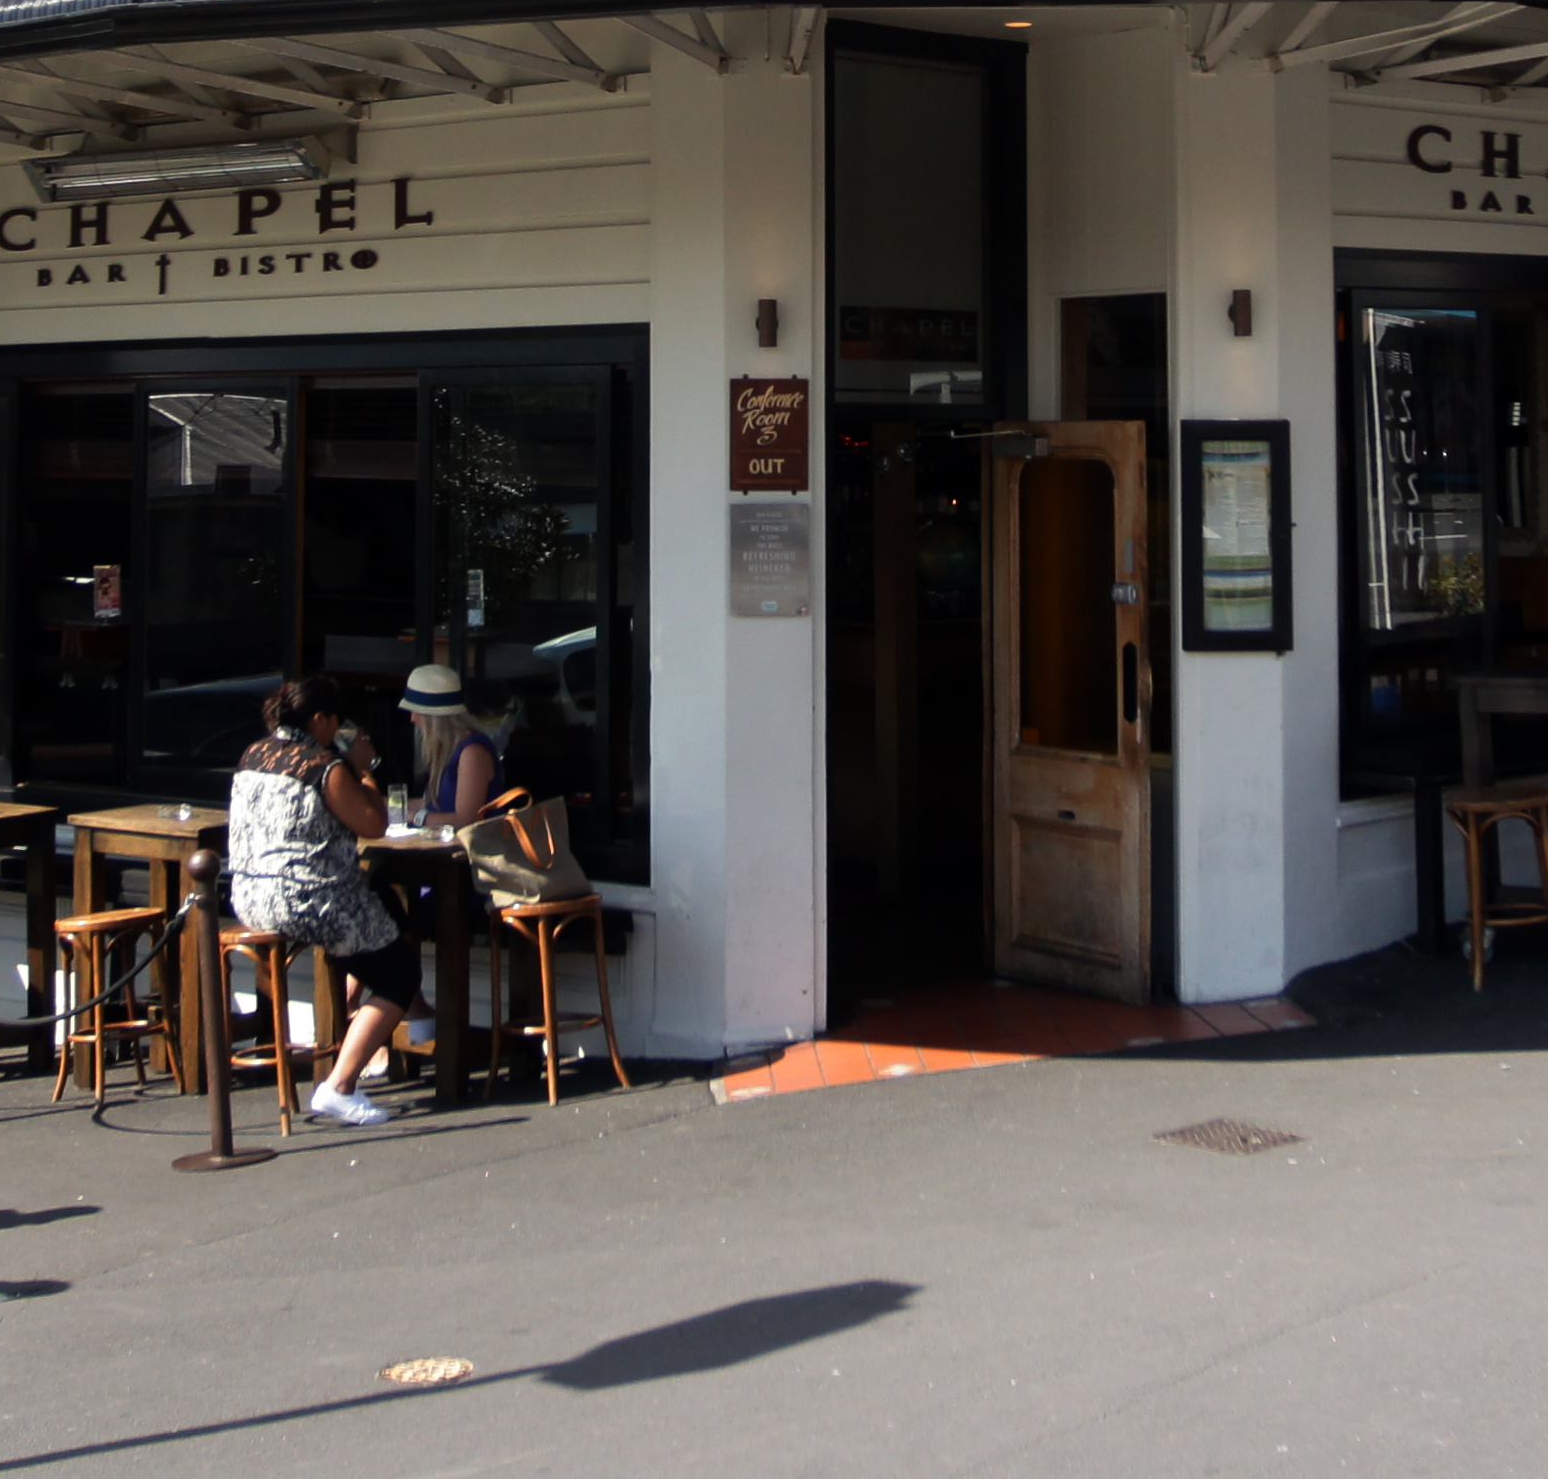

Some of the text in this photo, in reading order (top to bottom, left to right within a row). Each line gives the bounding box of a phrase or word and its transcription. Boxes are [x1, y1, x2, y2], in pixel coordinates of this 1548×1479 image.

[1450, 189, 1536, 216] BAR
[36, 247, 379, 288] BAR BISTRO
[737, 384, 805, 413] Conference
[741, 408, 791, 435] Room
[748, 458, 785, 475] OUT
